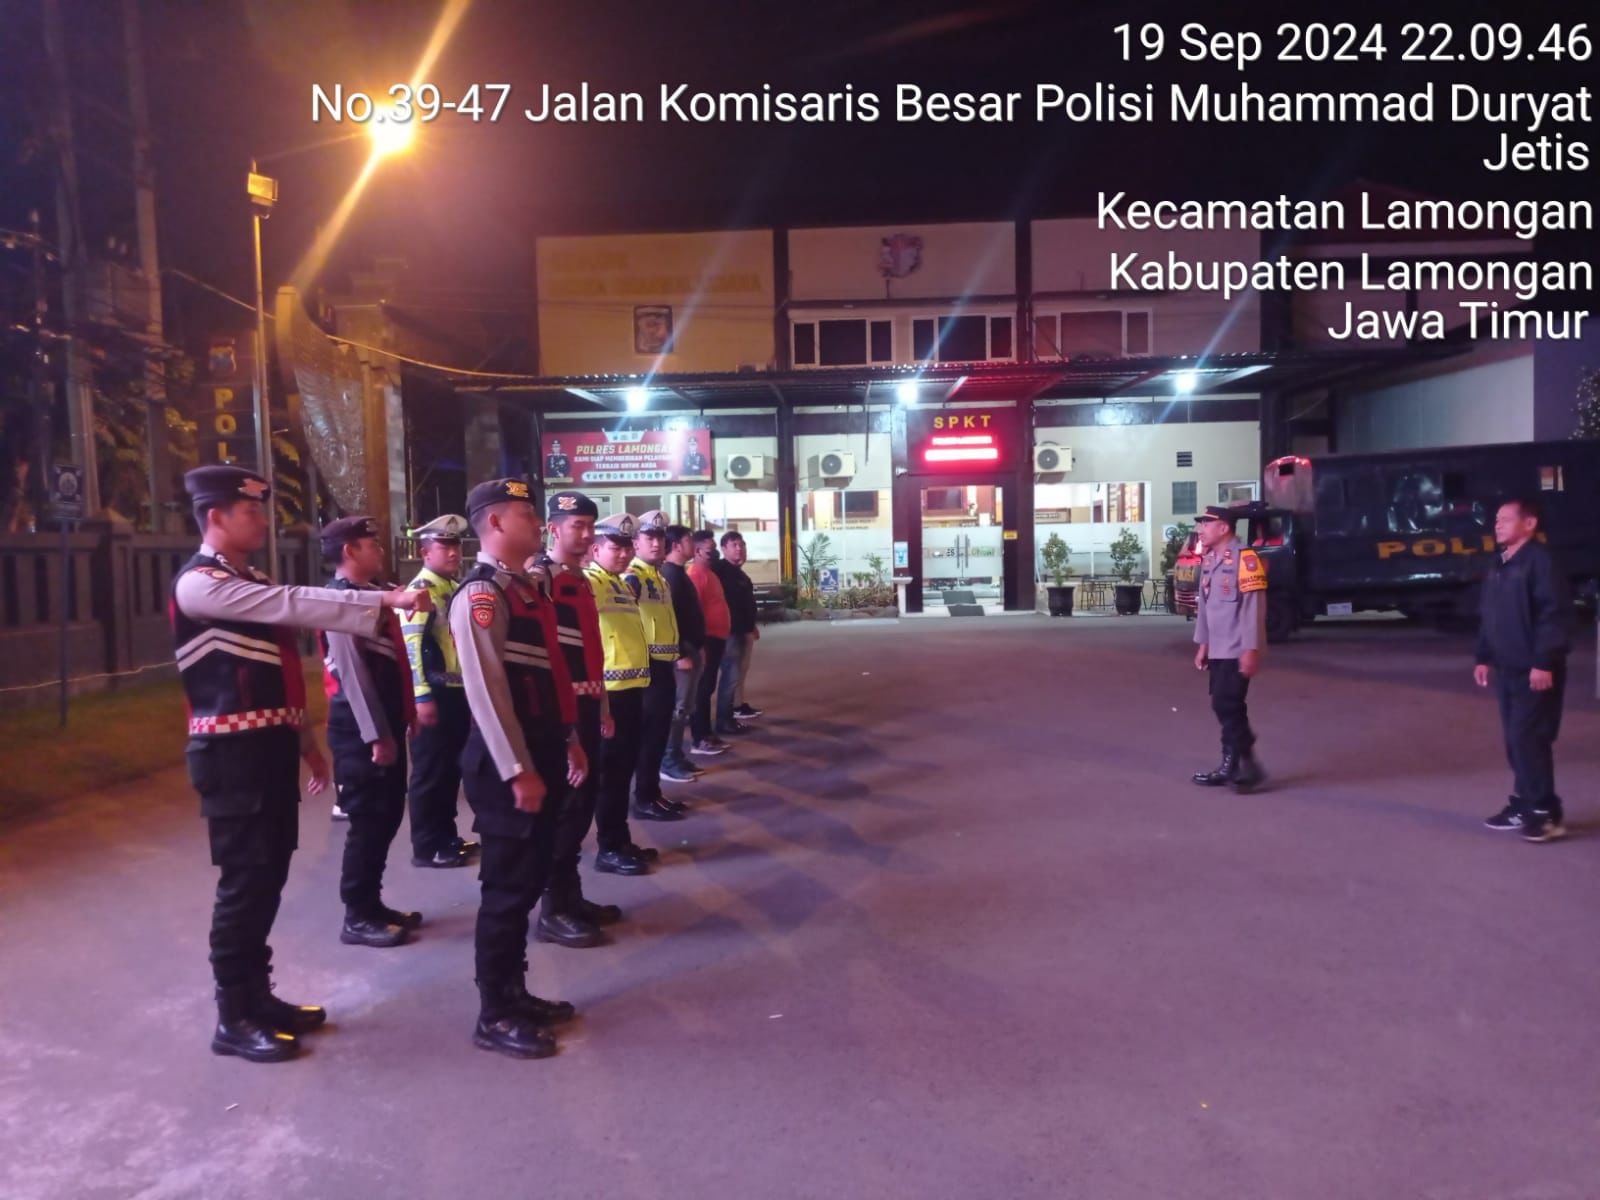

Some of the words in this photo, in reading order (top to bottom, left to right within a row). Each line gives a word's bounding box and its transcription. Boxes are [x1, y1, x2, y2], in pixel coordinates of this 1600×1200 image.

[934, 415, 991, 429] SPKT
[576, 445, 615, 454] POLRES
[618, 444, 674, 454] LAMONGA
